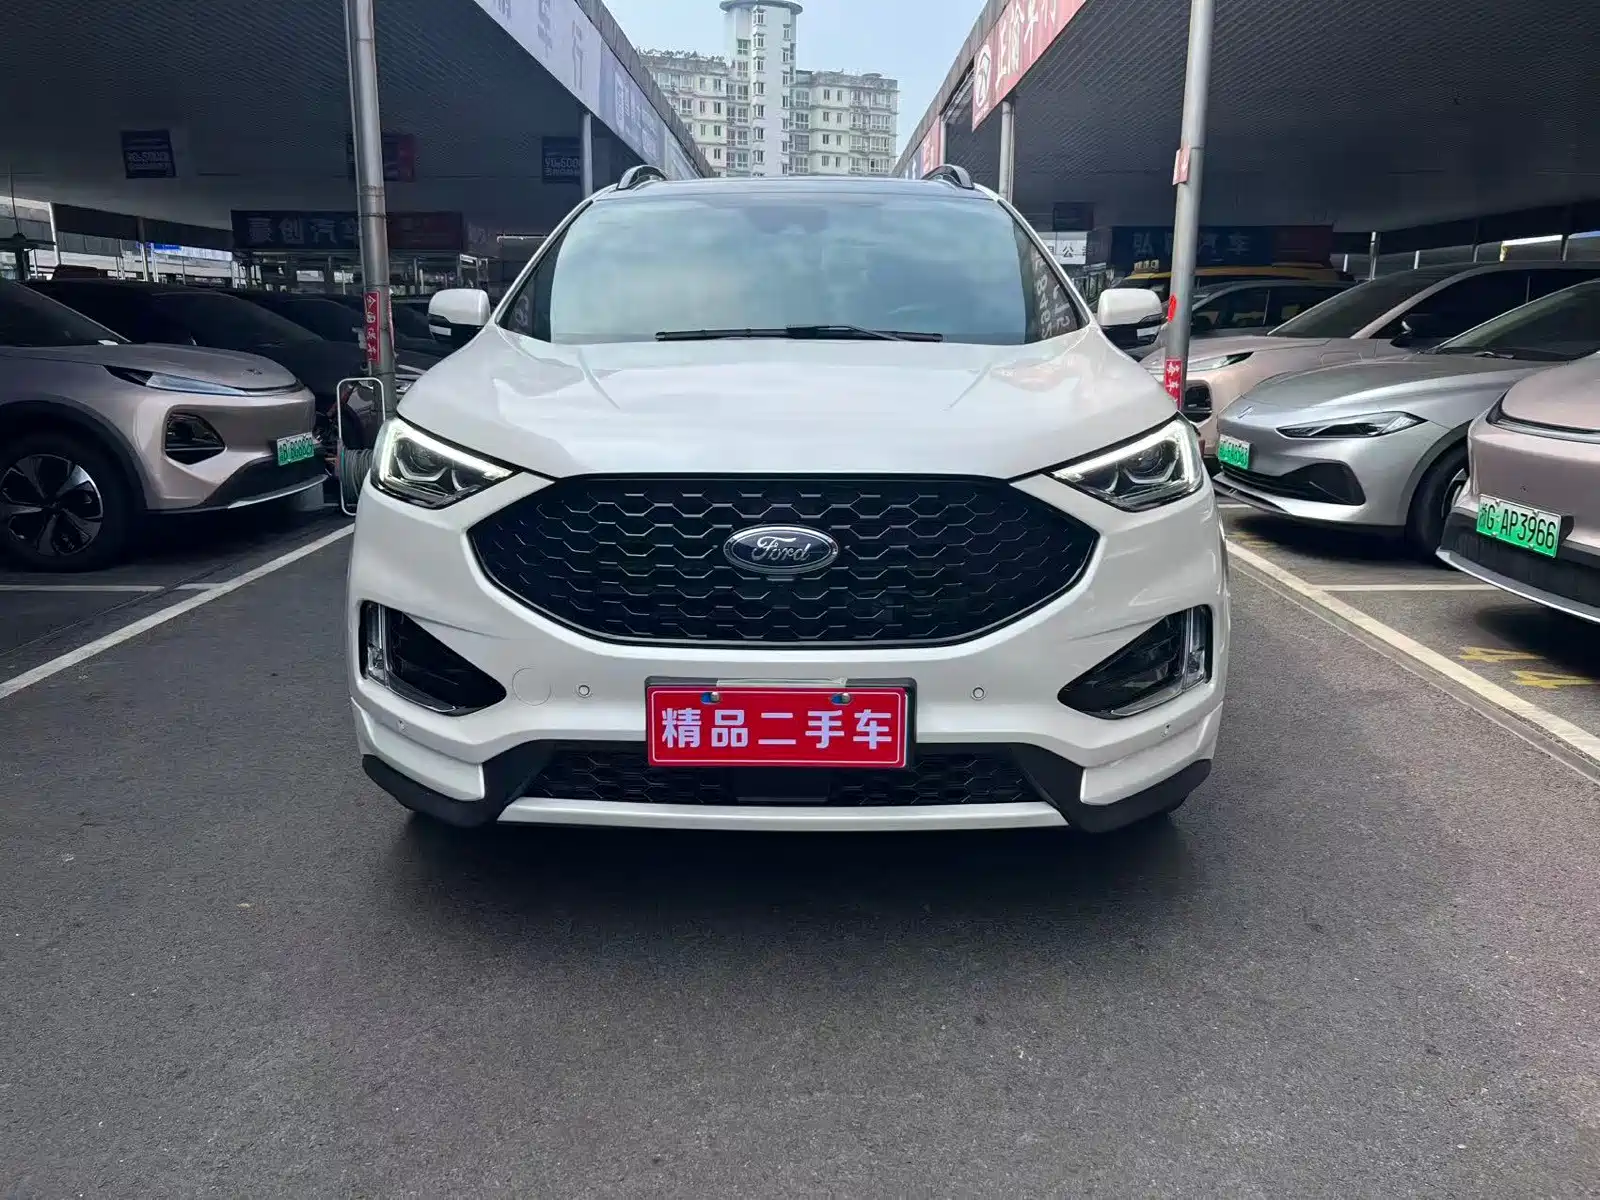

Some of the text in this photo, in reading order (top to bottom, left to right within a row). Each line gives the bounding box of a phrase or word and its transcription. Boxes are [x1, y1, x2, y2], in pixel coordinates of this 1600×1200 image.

[751, 536, 812, 561] Ford
[661, 707, 892, 750] 精品二手车
